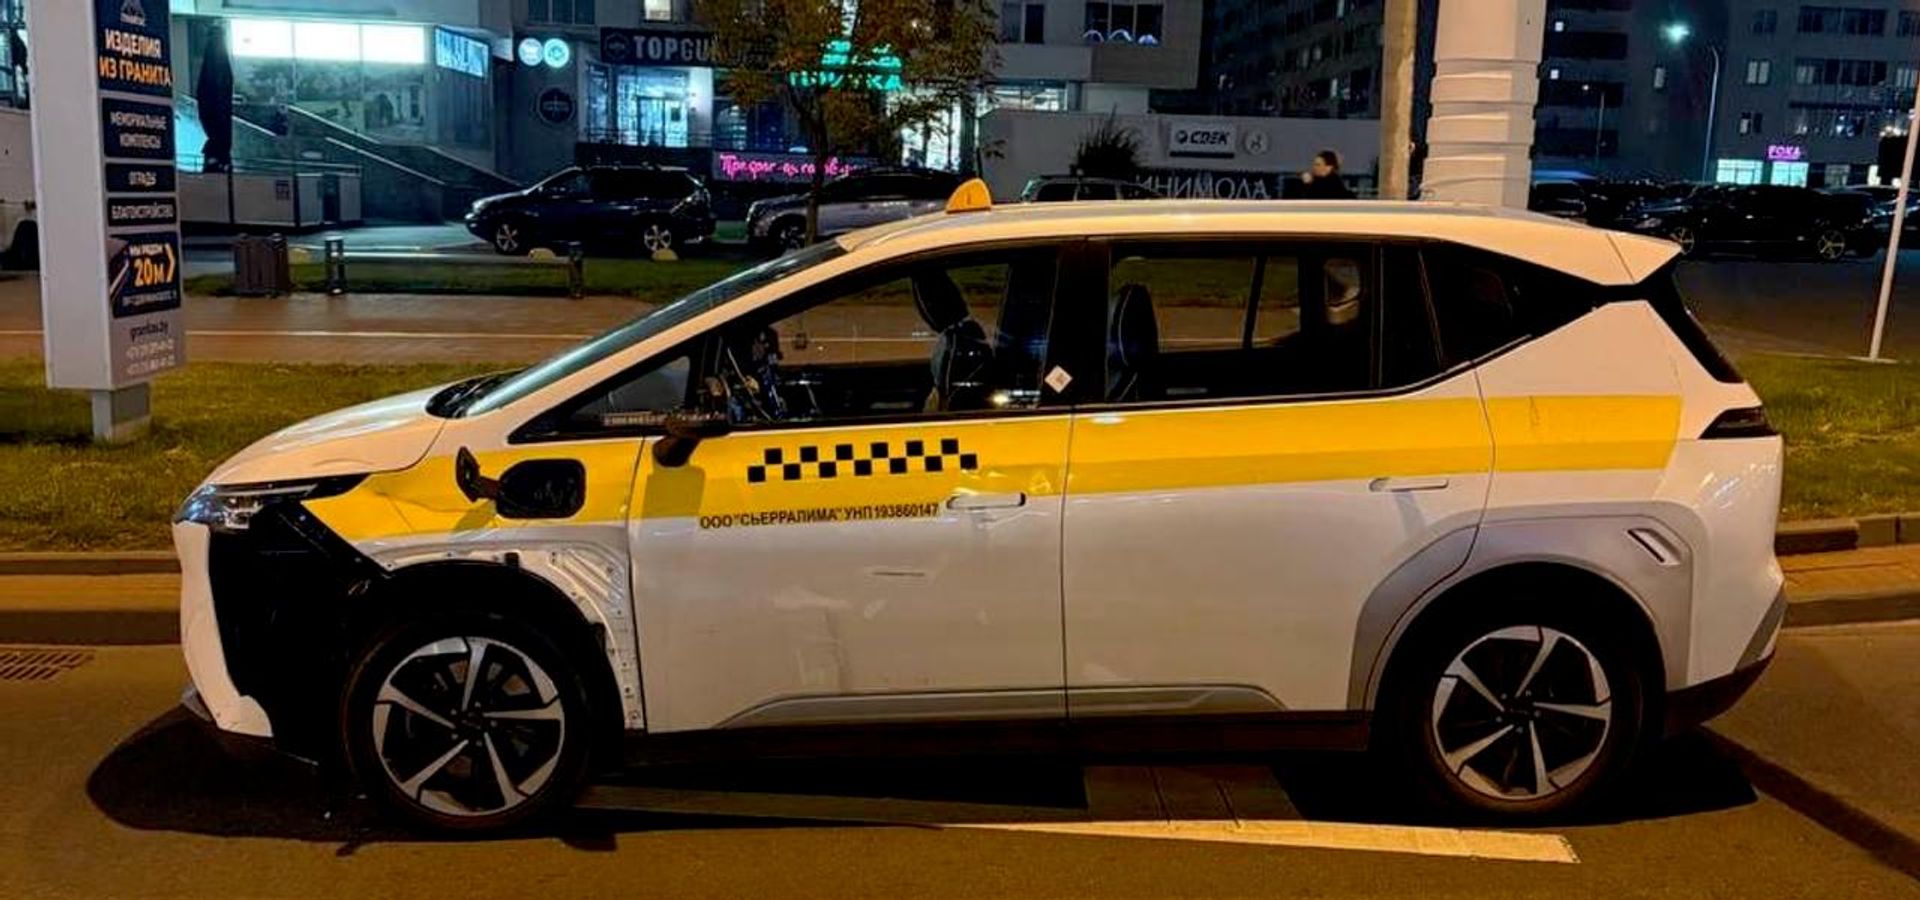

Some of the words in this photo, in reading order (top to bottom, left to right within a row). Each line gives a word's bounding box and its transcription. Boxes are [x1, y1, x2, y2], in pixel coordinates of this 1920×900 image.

[105, 29, 161, 58] ИЗДЕЛИЯ
[99, 55, 117, 77] ИЗ
[119, 60, 173, 86] ГРАНИТА
[700, 514, 733, 530] ООО
[733, 507, 842, 526] "СЬЕРРАЛИМА"
[844, 505, 872, 520] УНП
